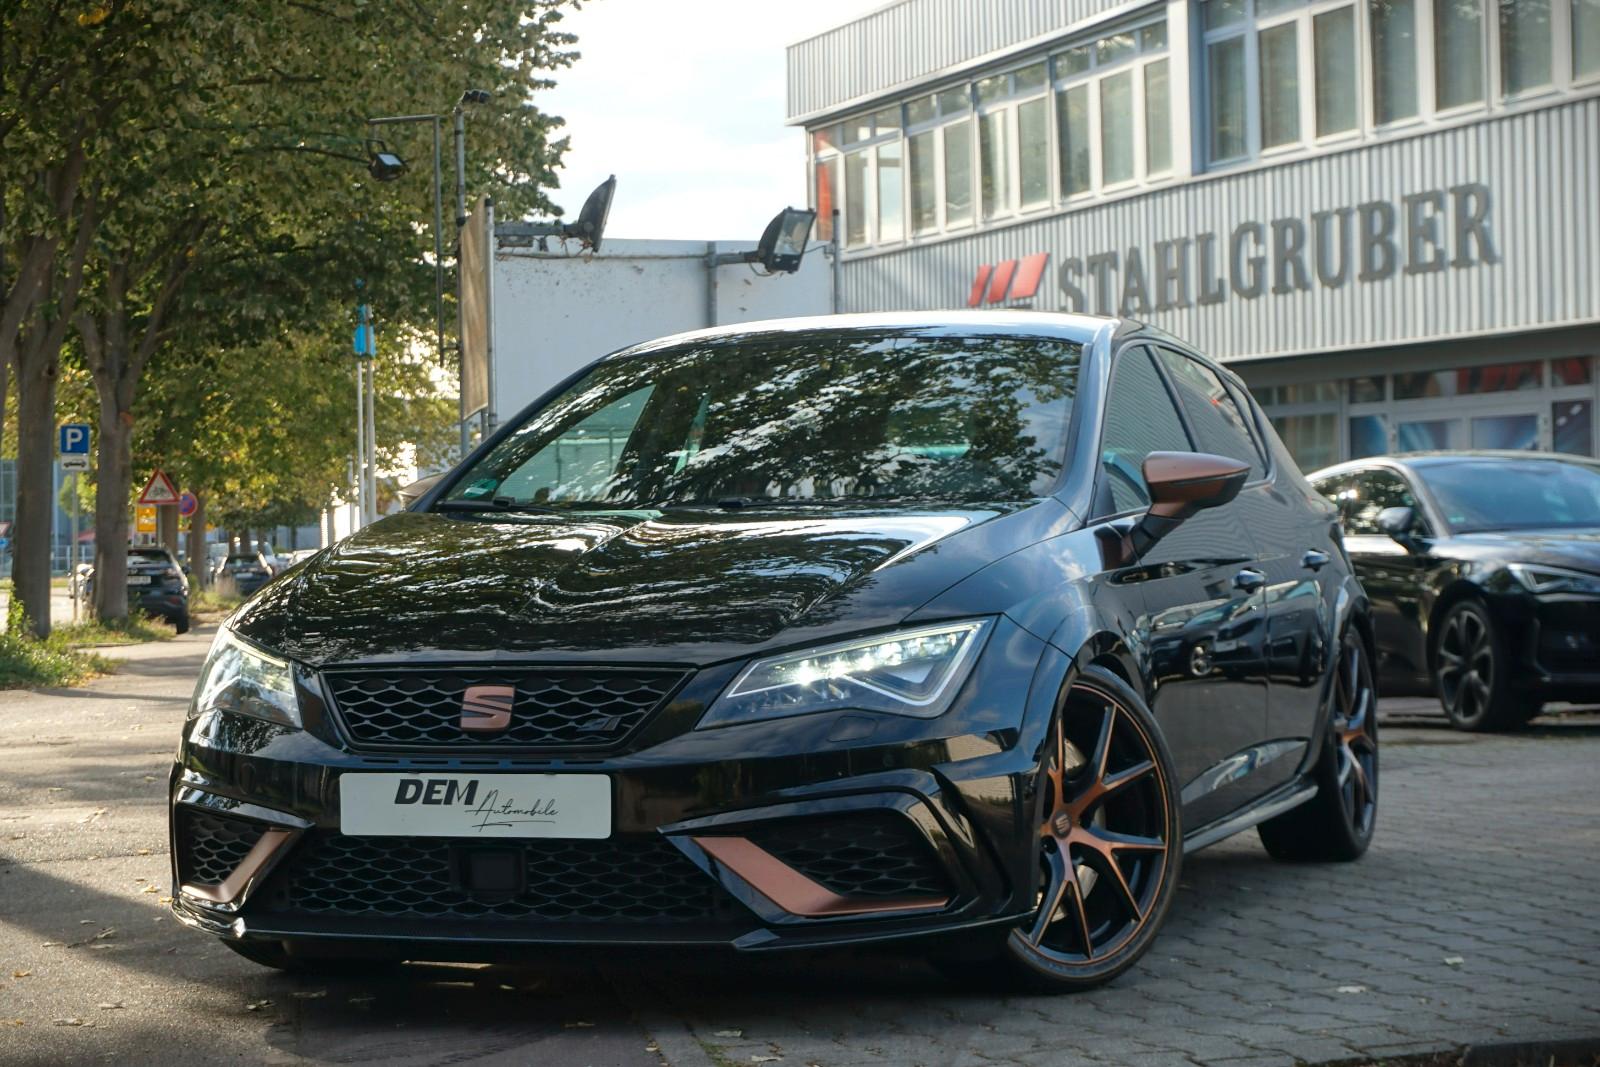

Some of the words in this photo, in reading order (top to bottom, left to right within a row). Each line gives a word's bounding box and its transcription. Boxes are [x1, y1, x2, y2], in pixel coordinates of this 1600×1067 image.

[1058, 182, 1499, 318] STAHLGRUBER
[66, 428, 83, 451] P
[394, 778, 479, 806] DEM
[464, 788, 559, 833] Automobile
